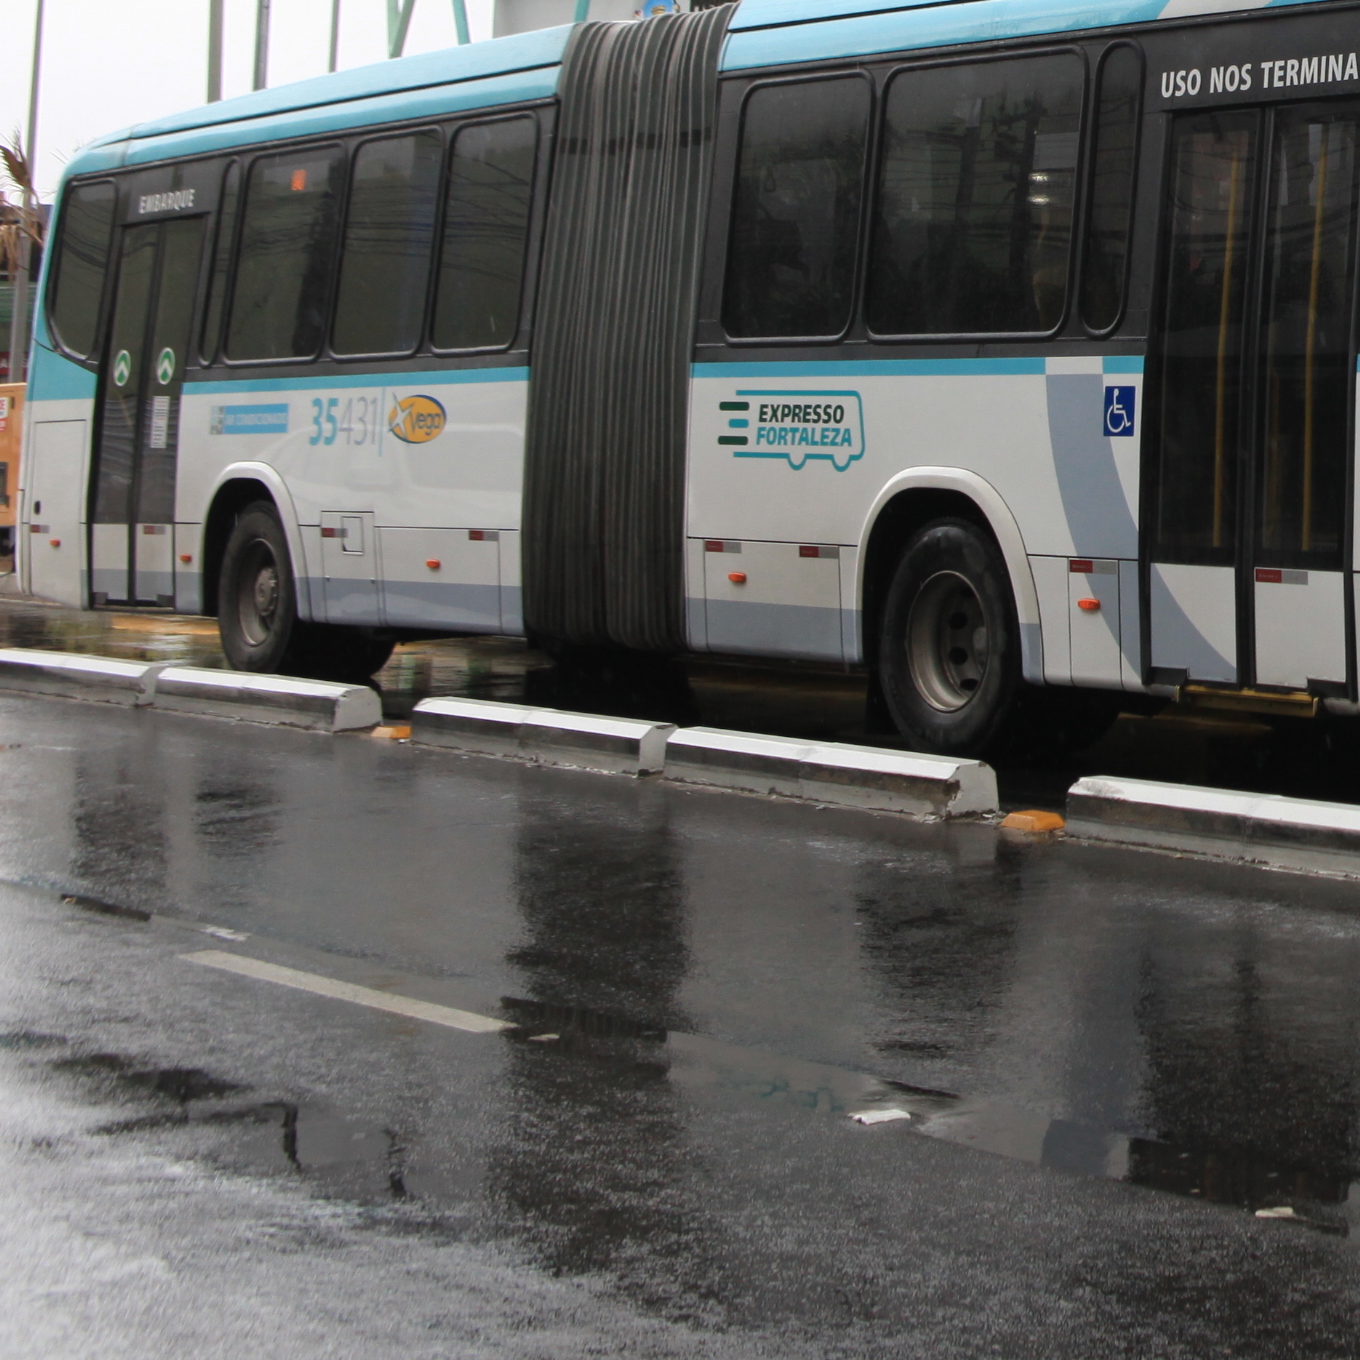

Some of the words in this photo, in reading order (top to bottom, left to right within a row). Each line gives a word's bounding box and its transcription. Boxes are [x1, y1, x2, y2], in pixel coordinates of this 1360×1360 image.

[1161, 69, 1202, 98] USO
[1209, 63, 1252, 94] NOS
[138, 188, 196, 214] EMBARQUE
[758, 403, 845, 424] EXPRESSO
[755, 426, 853, 447] FORTALEZA
